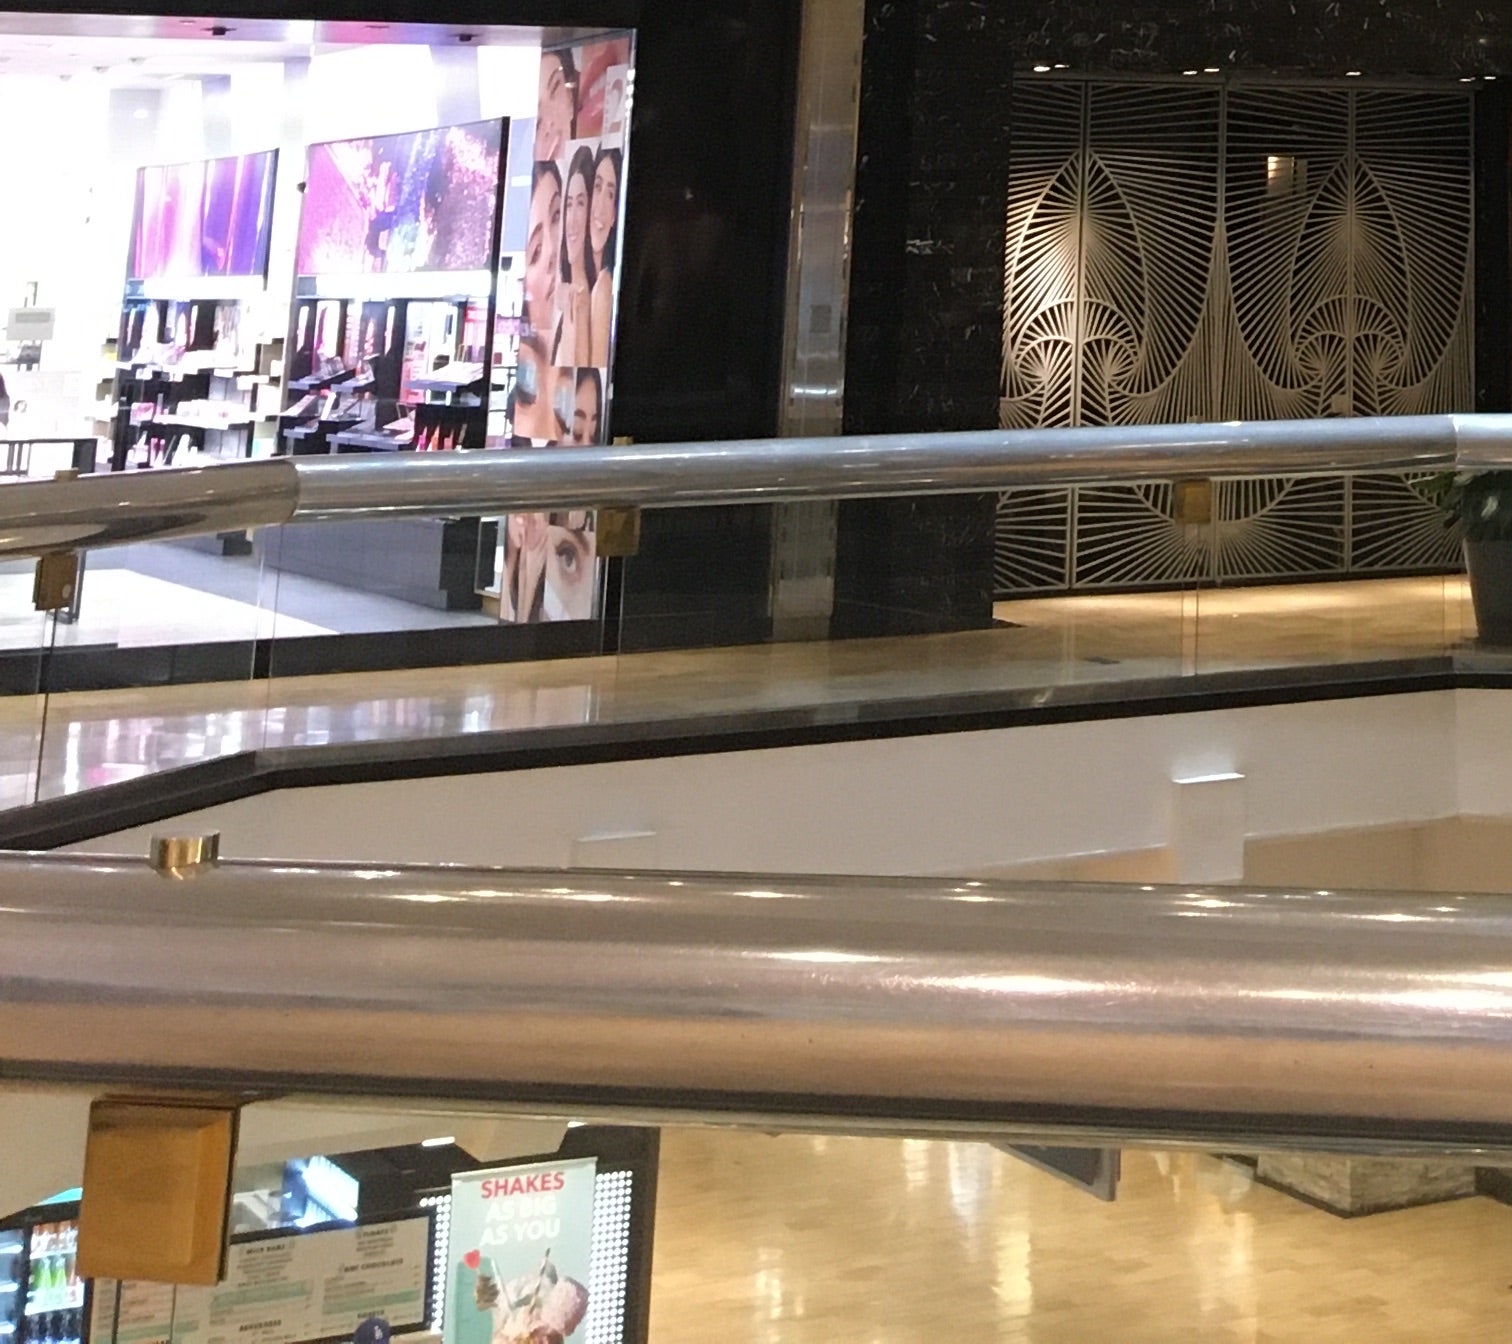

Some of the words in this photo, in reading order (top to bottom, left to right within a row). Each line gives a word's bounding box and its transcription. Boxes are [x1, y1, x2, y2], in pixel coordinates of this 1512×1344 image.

[481, 1171, 565, 1199] SHAKES
[485, 1200, 515, 1223] AS
[479, 1225, 509, 1247] AS
[514, 1218, 561, 1242] YOU
